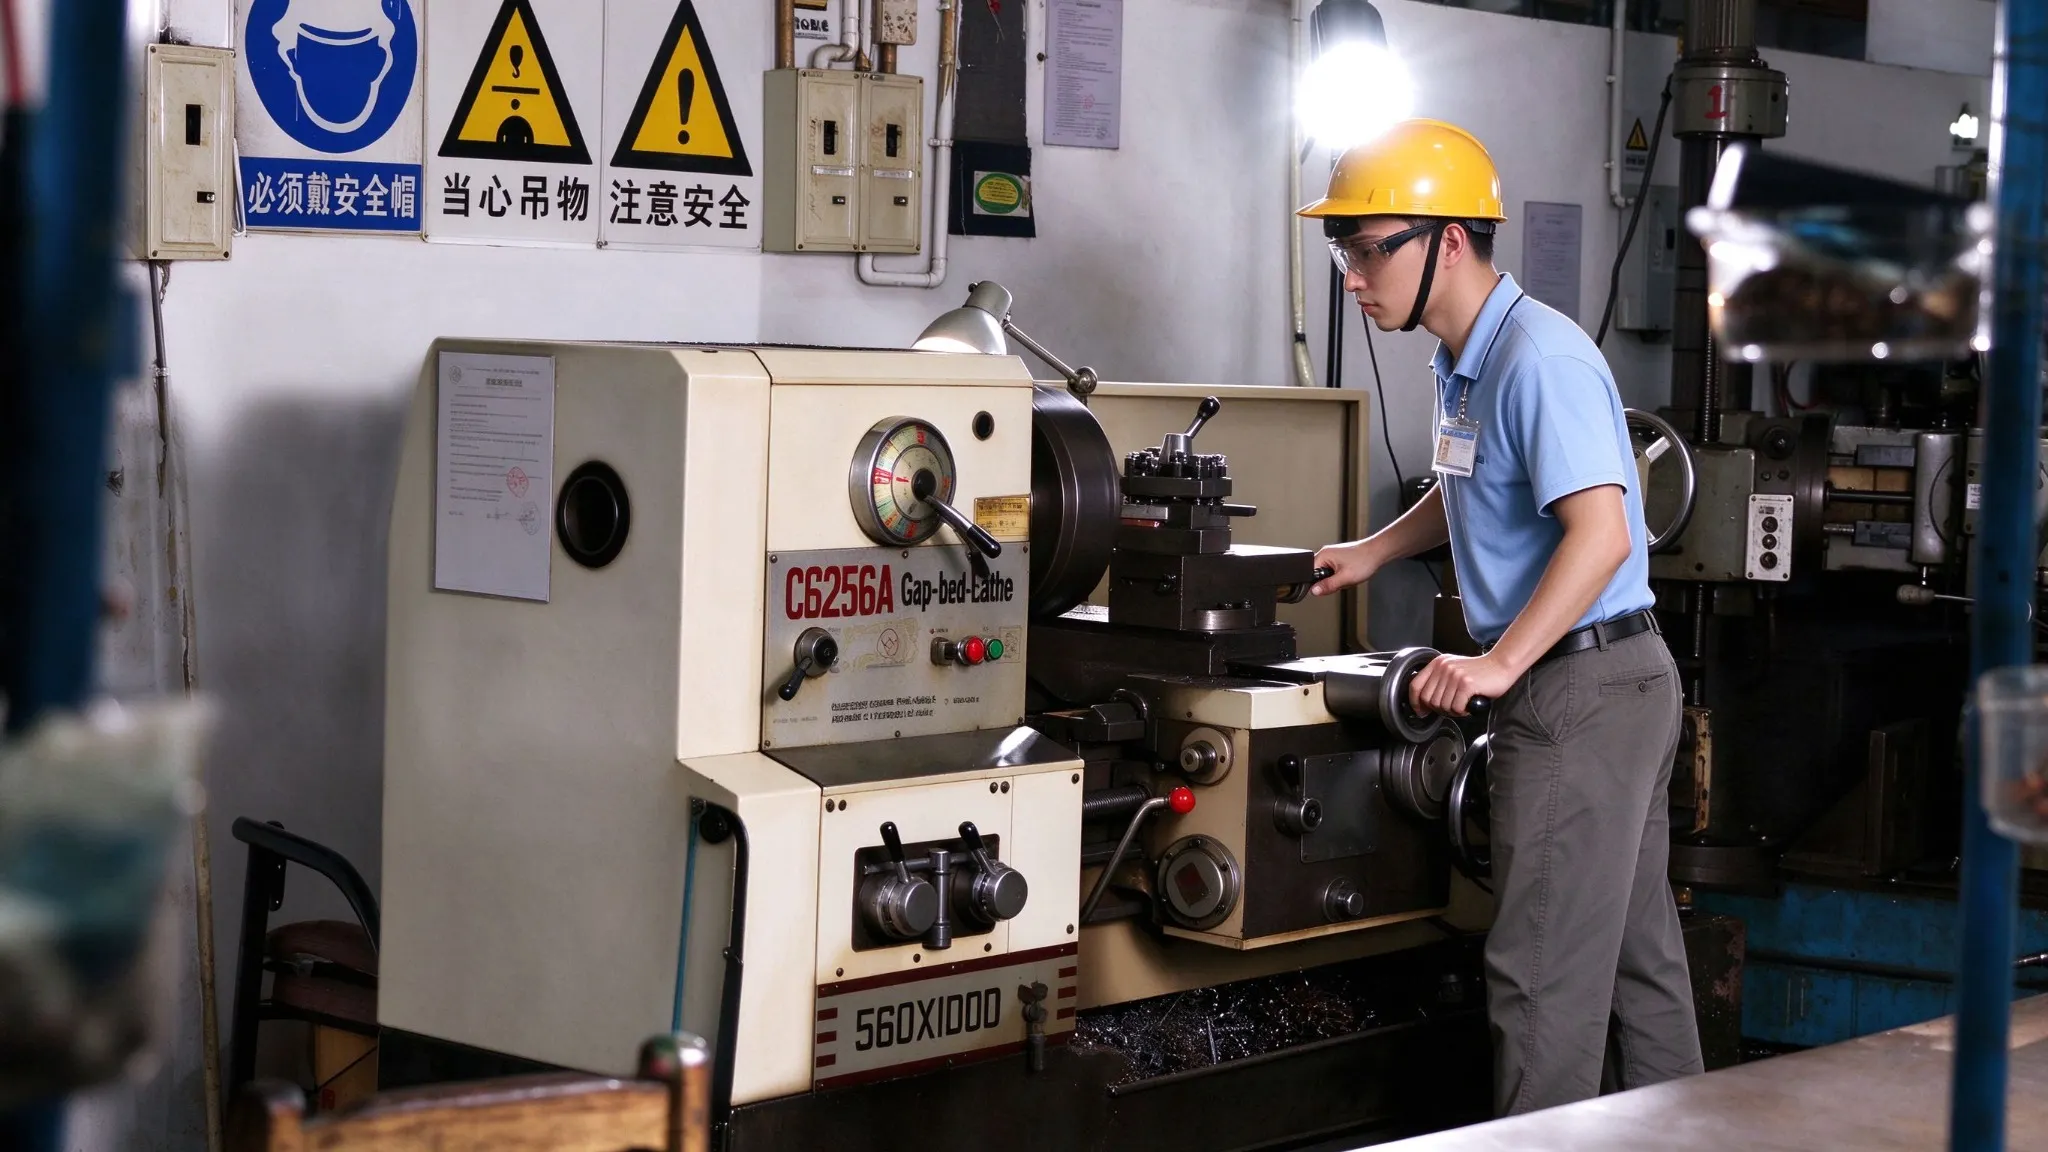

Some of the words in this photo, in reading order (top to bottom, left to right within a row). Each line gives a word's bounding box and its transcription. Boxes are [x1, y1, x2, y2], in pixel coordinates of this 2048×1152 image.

[1704, 85, 1728, 119] 1
[248, 172, 416, 219] 必须戴安全帽
[442, 173, 589, 221] 当心吊物
[609, 179, 751, 230] 注意安全
[785, 564, 894, 620] C6256A
[855, 987, 1002, 1051] 560X1000
